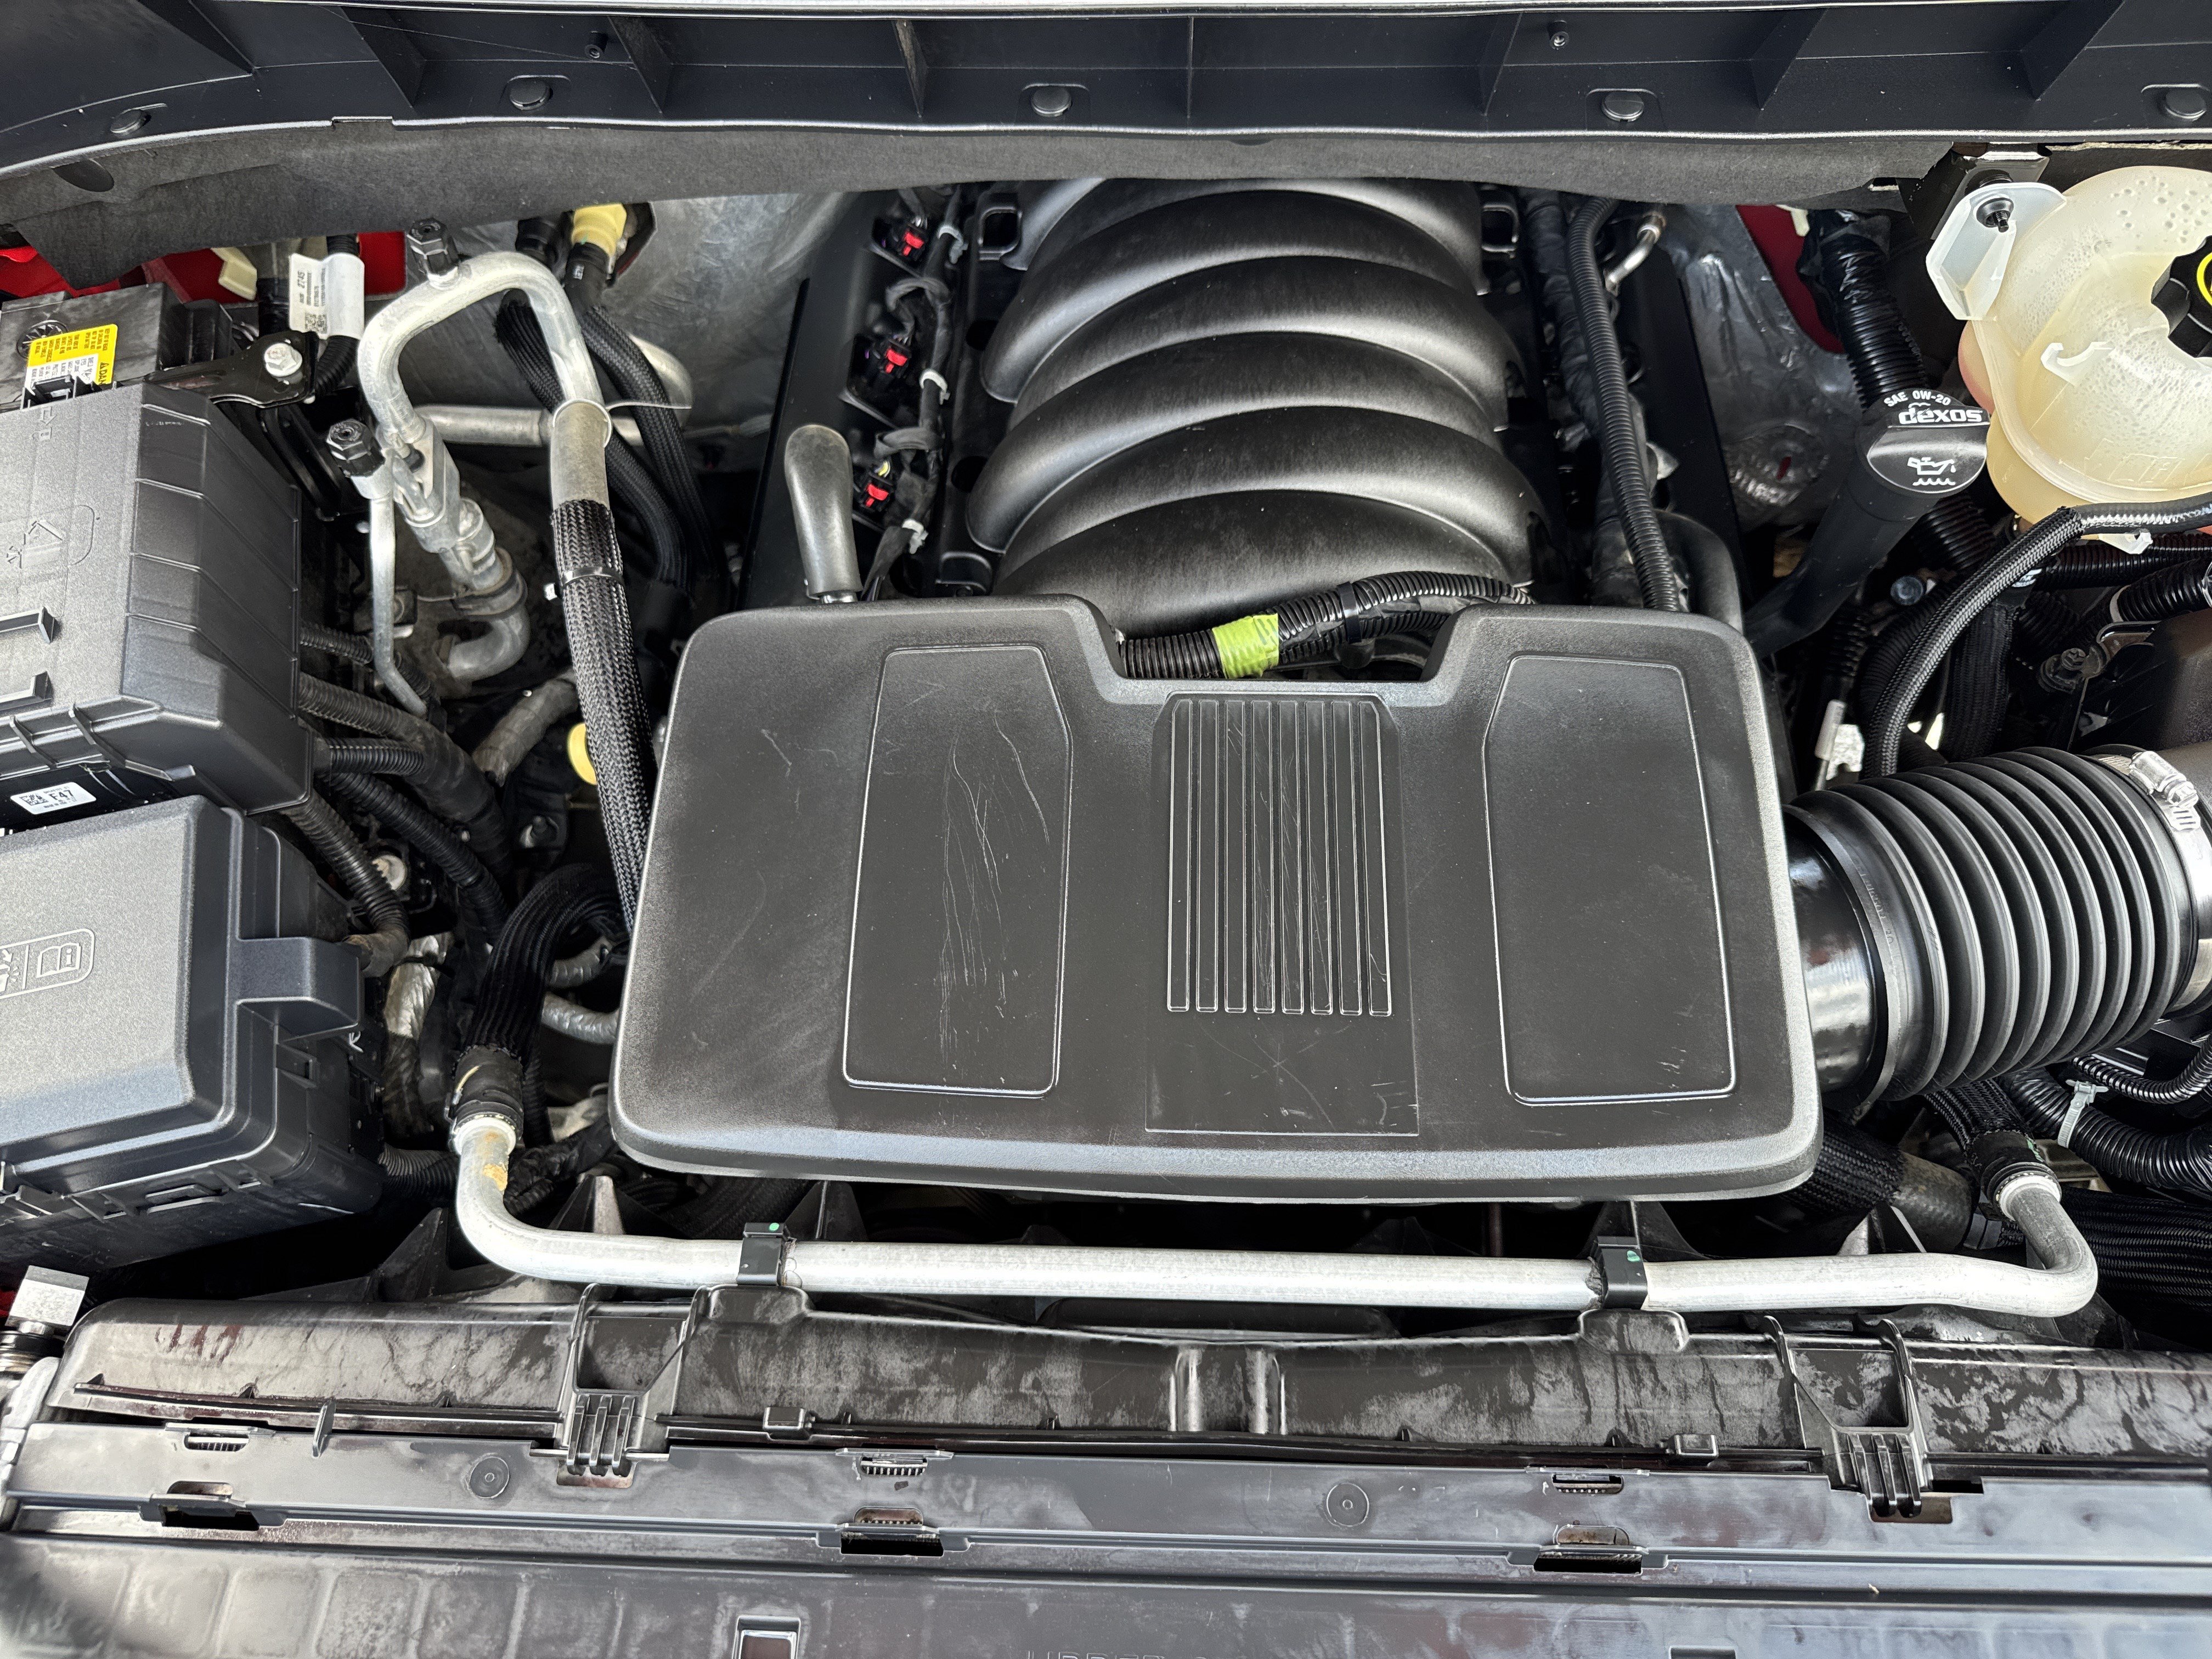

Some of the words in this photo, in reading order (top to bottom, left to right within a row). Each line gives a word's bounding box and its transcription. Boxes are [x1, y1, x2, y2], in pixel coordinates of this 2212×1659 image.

[1883, 391, 1908, 407] SAE
[1912, 390, 1951, 405] 0W-20
[1898, 407, 1983, 425] dexos
[48, 789, 74, 800] F47
